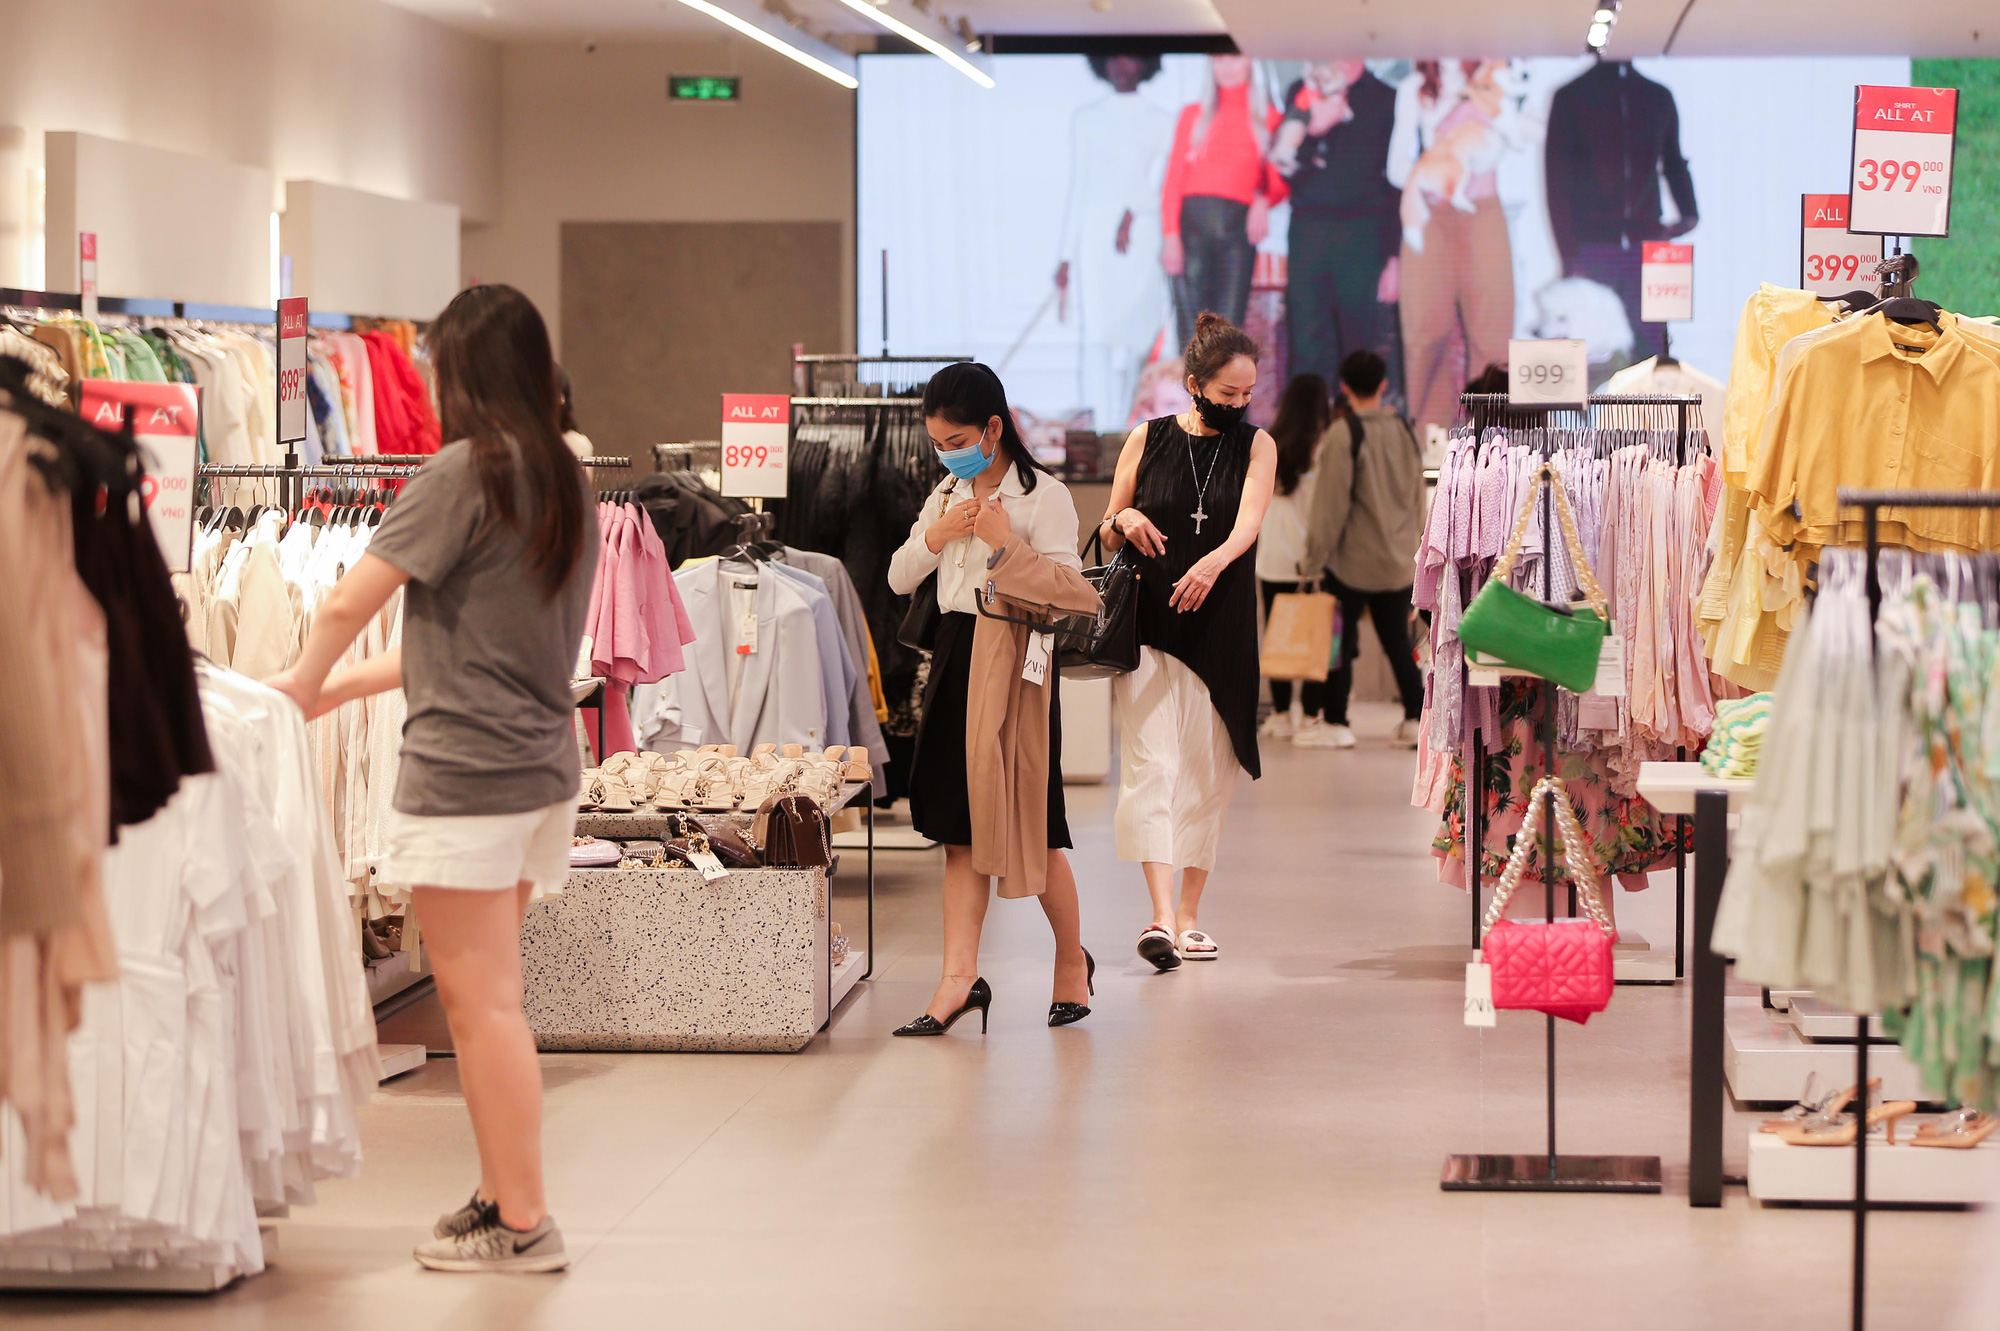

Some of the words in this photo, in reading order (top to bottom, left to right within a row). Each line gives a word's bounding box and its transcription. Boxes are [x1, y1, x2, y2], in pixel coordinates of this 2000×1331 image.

[1874, 108, 1904, 121] ALL
[1910, 110, 1935, 122] AT
[1857, 158, 1921, 193] 399
[1923, 161, 1943, 172] 000
[1922, 185, 1942, 195] VND
[1814, 208, 1844, 221] ALL
[1806, 254, 1859, 281] 399
[1860, 254, 1877, 264] 000
[1860, 274, 1877, 282] VND
[283, 315, 294, 330] ALL
[295, 314, 304, 329] AT
[1518, 364, 1564, 384] 999
[280, 368, 299, 402] 899
[95, 401, 140, 425] AL
[150, 405, 184, 425] AT
[730, 406, 756, 418] ALL
[761, 406, 780, 418] AT
[725, 445, 768, 468] 899
[162, 477, 187, 491] 000
[160, 507, 185, 519] VND
